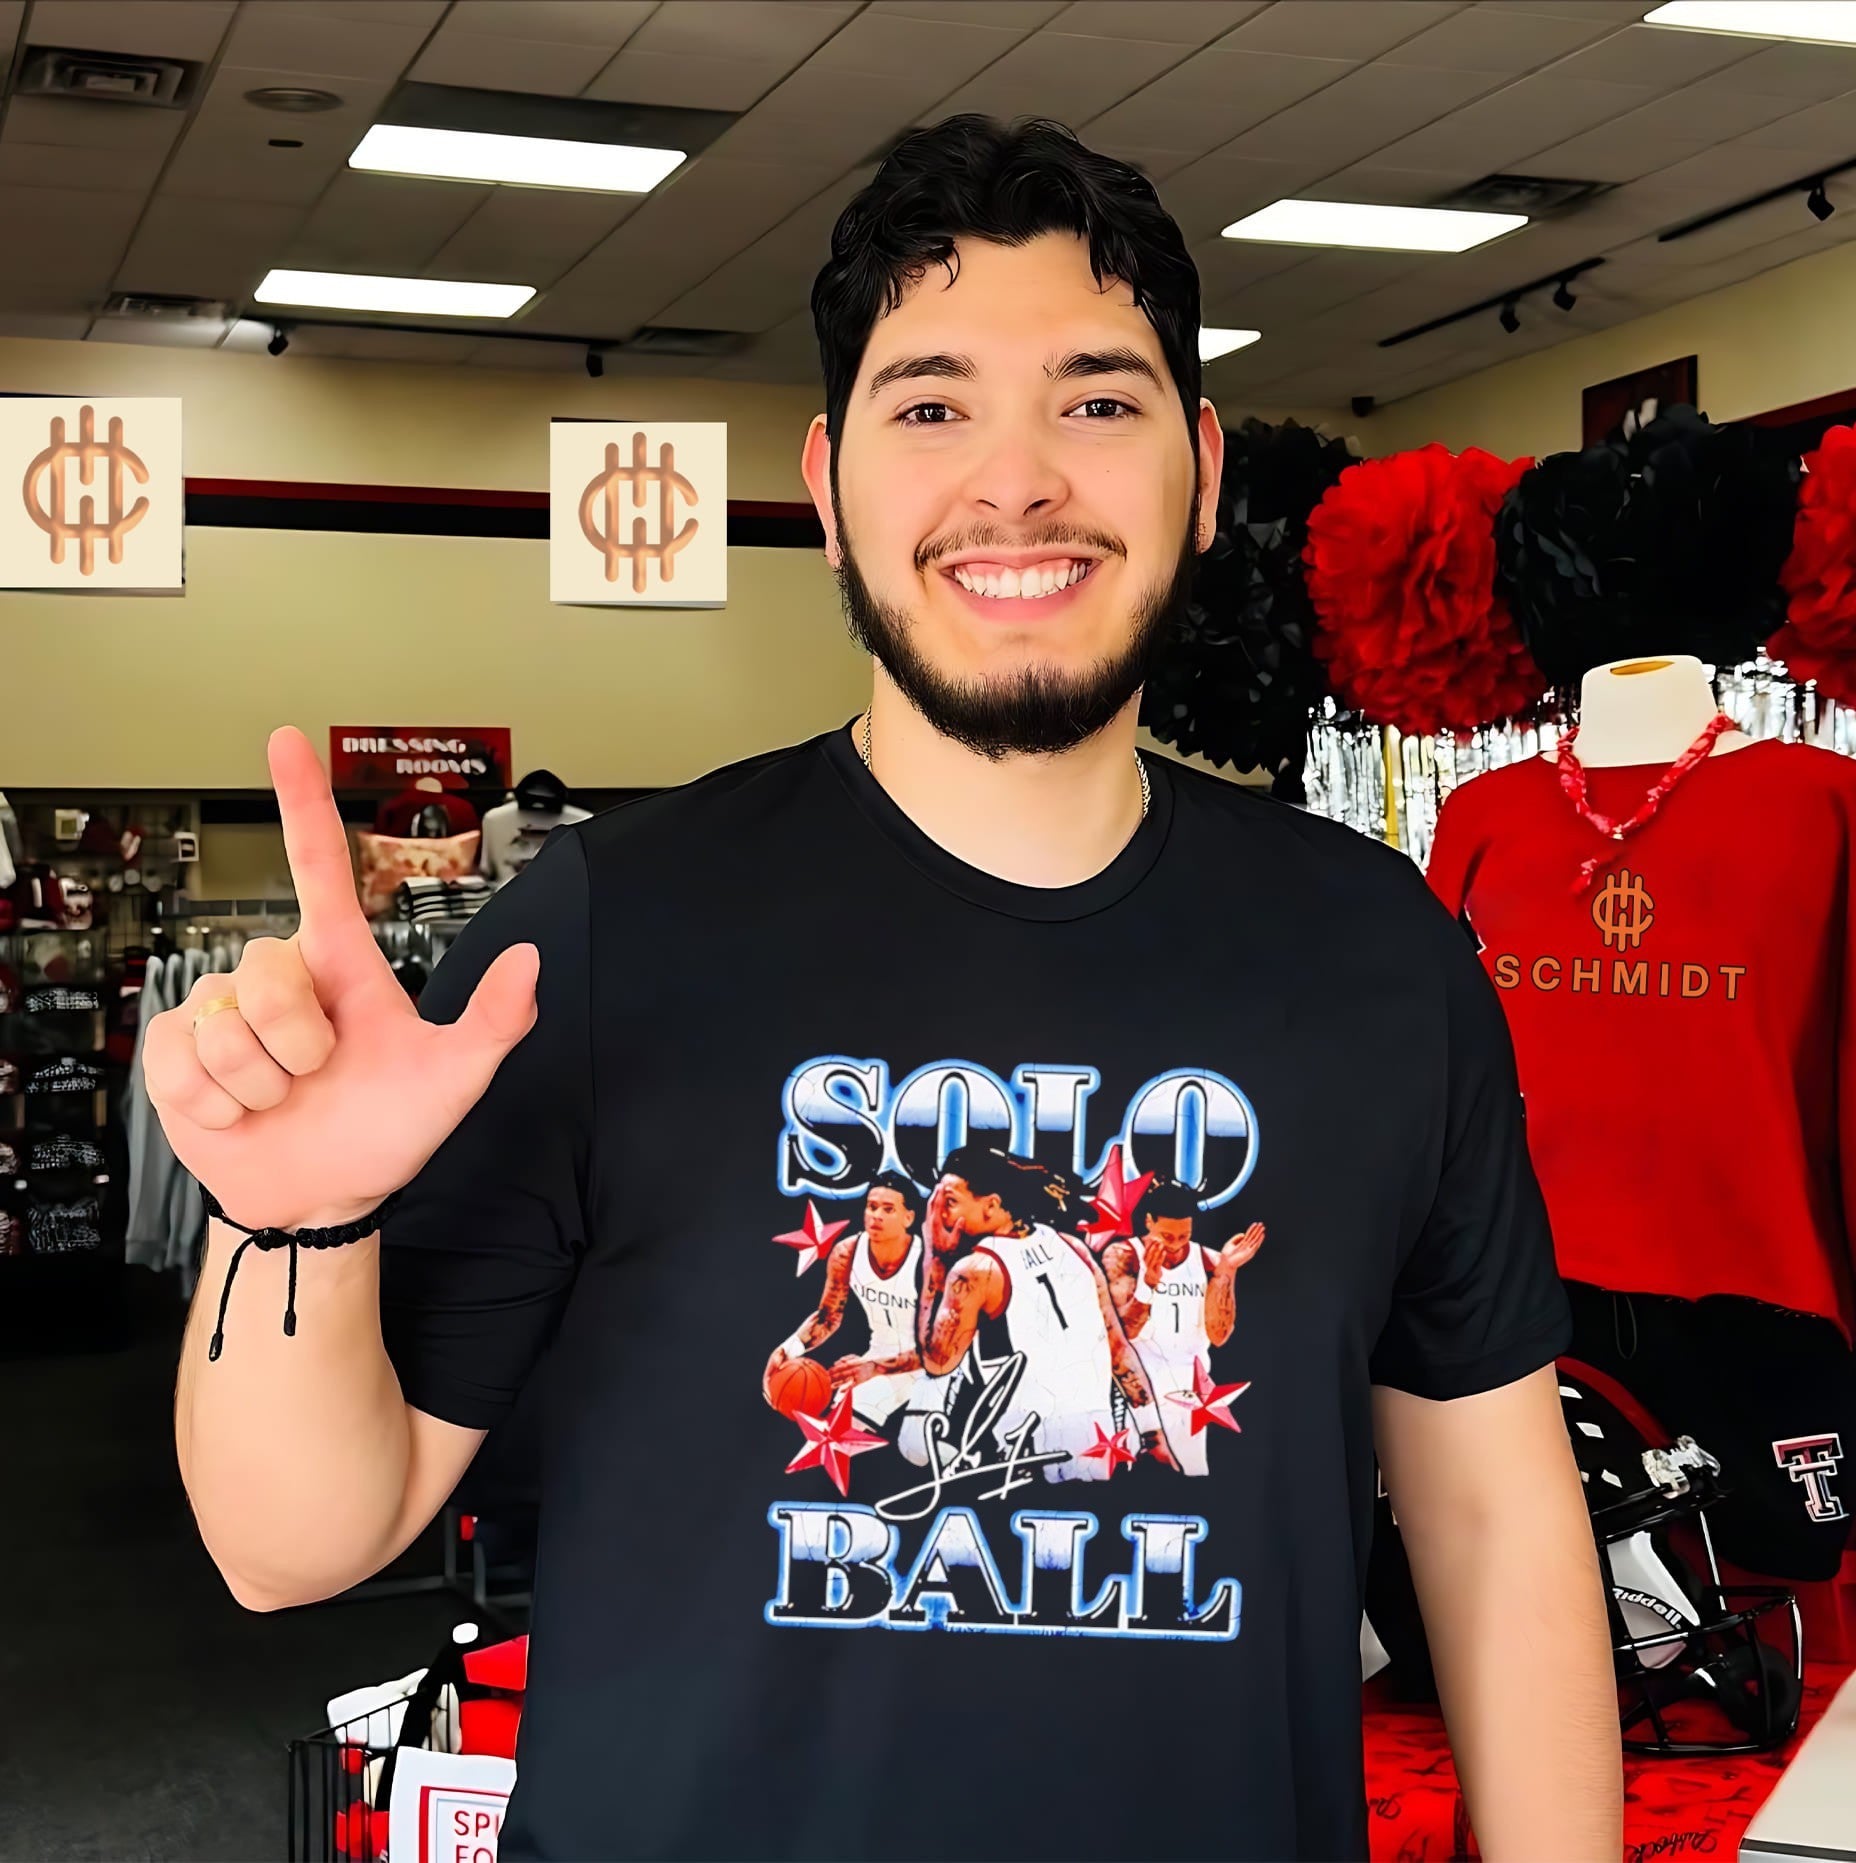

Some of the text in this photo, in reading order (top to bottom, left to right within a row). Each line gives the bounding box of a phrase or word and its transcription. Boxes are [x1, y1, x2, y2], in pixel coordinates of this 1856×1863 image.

[341, 737, 467, 754] DRESSING
[395, 758, 487, 775] ROOMS
[1494, 953, 1747, 1000] SCHMIDT
[778, 1055, 1260, 1211] SOLO
[1020, 1243, 1054, 1271] ALL
[1035, 1271, 1069, 1331] 1
[764, 1500, 1241, 1641] BALL
